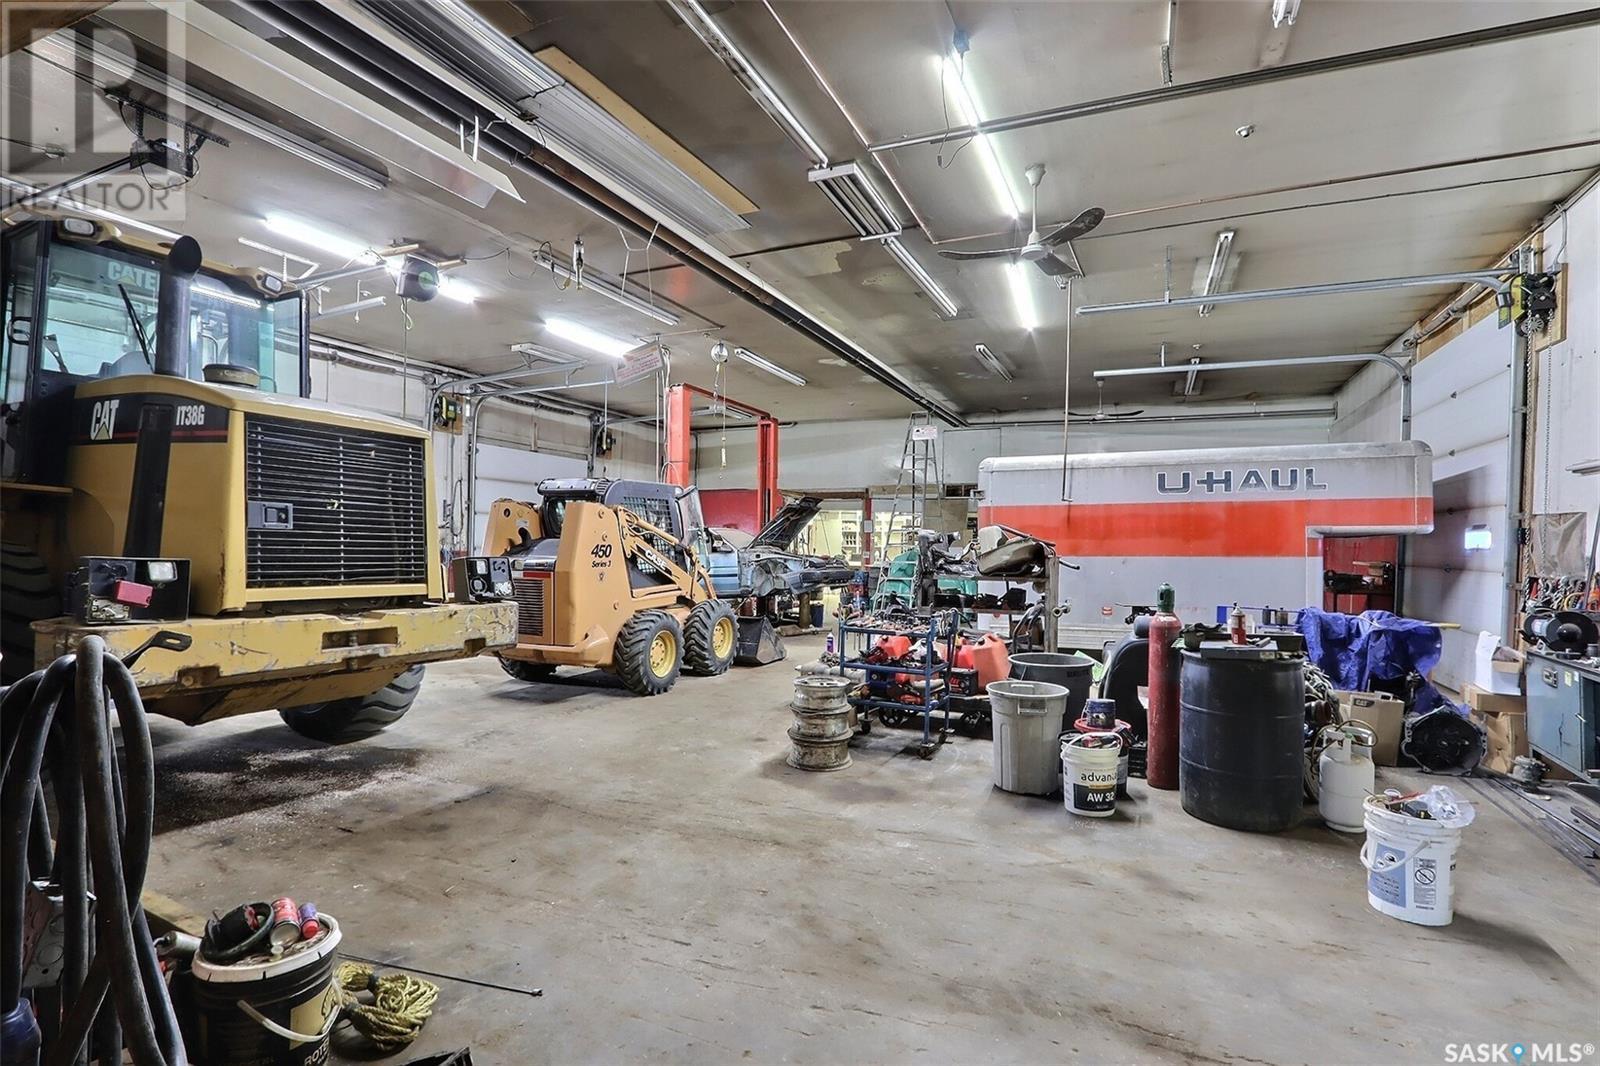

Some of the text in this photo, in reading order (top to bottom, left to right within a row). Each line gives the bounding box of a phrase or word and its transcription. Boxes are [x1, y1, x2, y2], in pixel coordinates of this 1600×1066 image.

[90, 399, 120, 440] CAT
[175, 404, 206, 426] IT38G
[590, 543, 613, 558] 450
[591, 560, 606, 568] Series
[645, 550, 667, 571] CASE
[1087, 792, 1115, 802] AW 32
